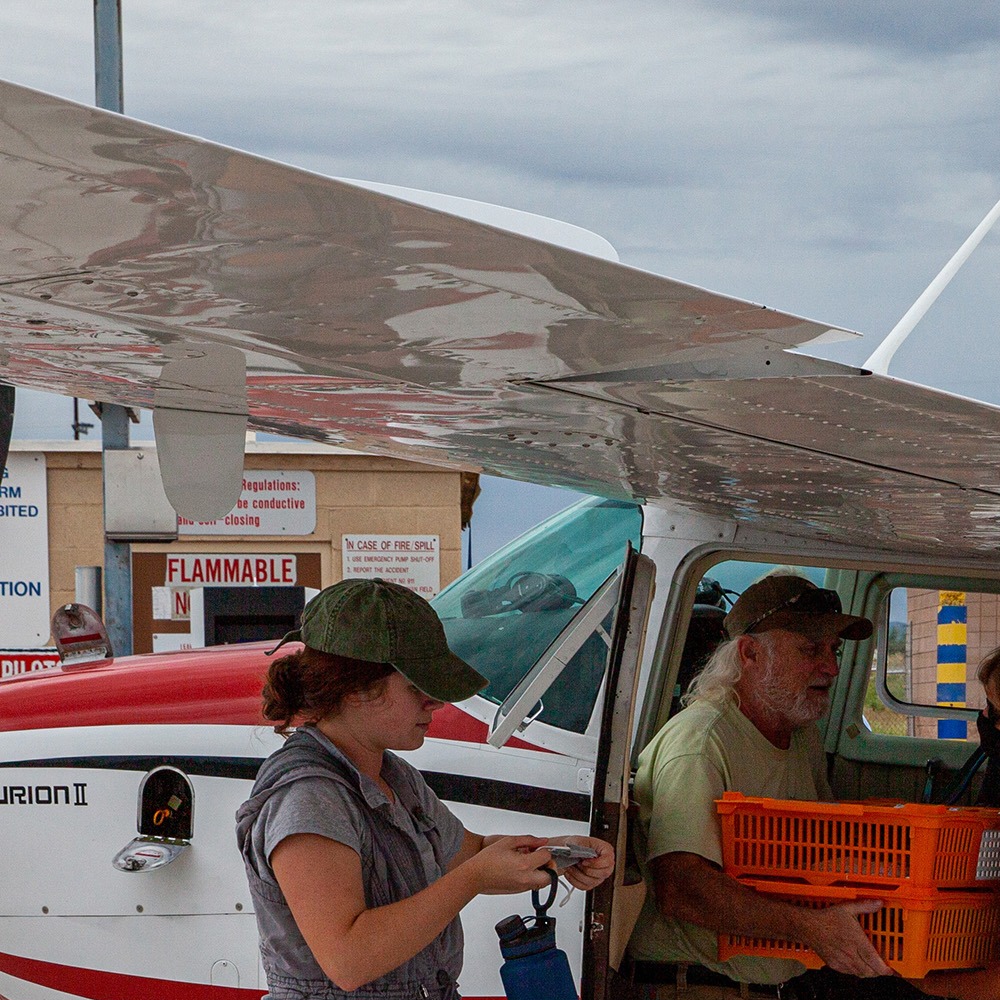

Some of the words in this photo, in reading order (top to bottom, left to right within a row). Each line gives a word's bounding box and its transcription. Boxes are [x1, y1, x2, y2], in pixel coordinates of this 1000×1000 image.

[242, 479, 300, 492] Regulations:
[252, 498, 305, 509] conductive
[346, 540, 354, 550] IN
[357, 540, 377, 550] CASE
[381, 540, 391, 550] OF
[394, 540, 434, 550] FIRE/SPILL
[168, 558, 293, 582] FLAMMABLE
